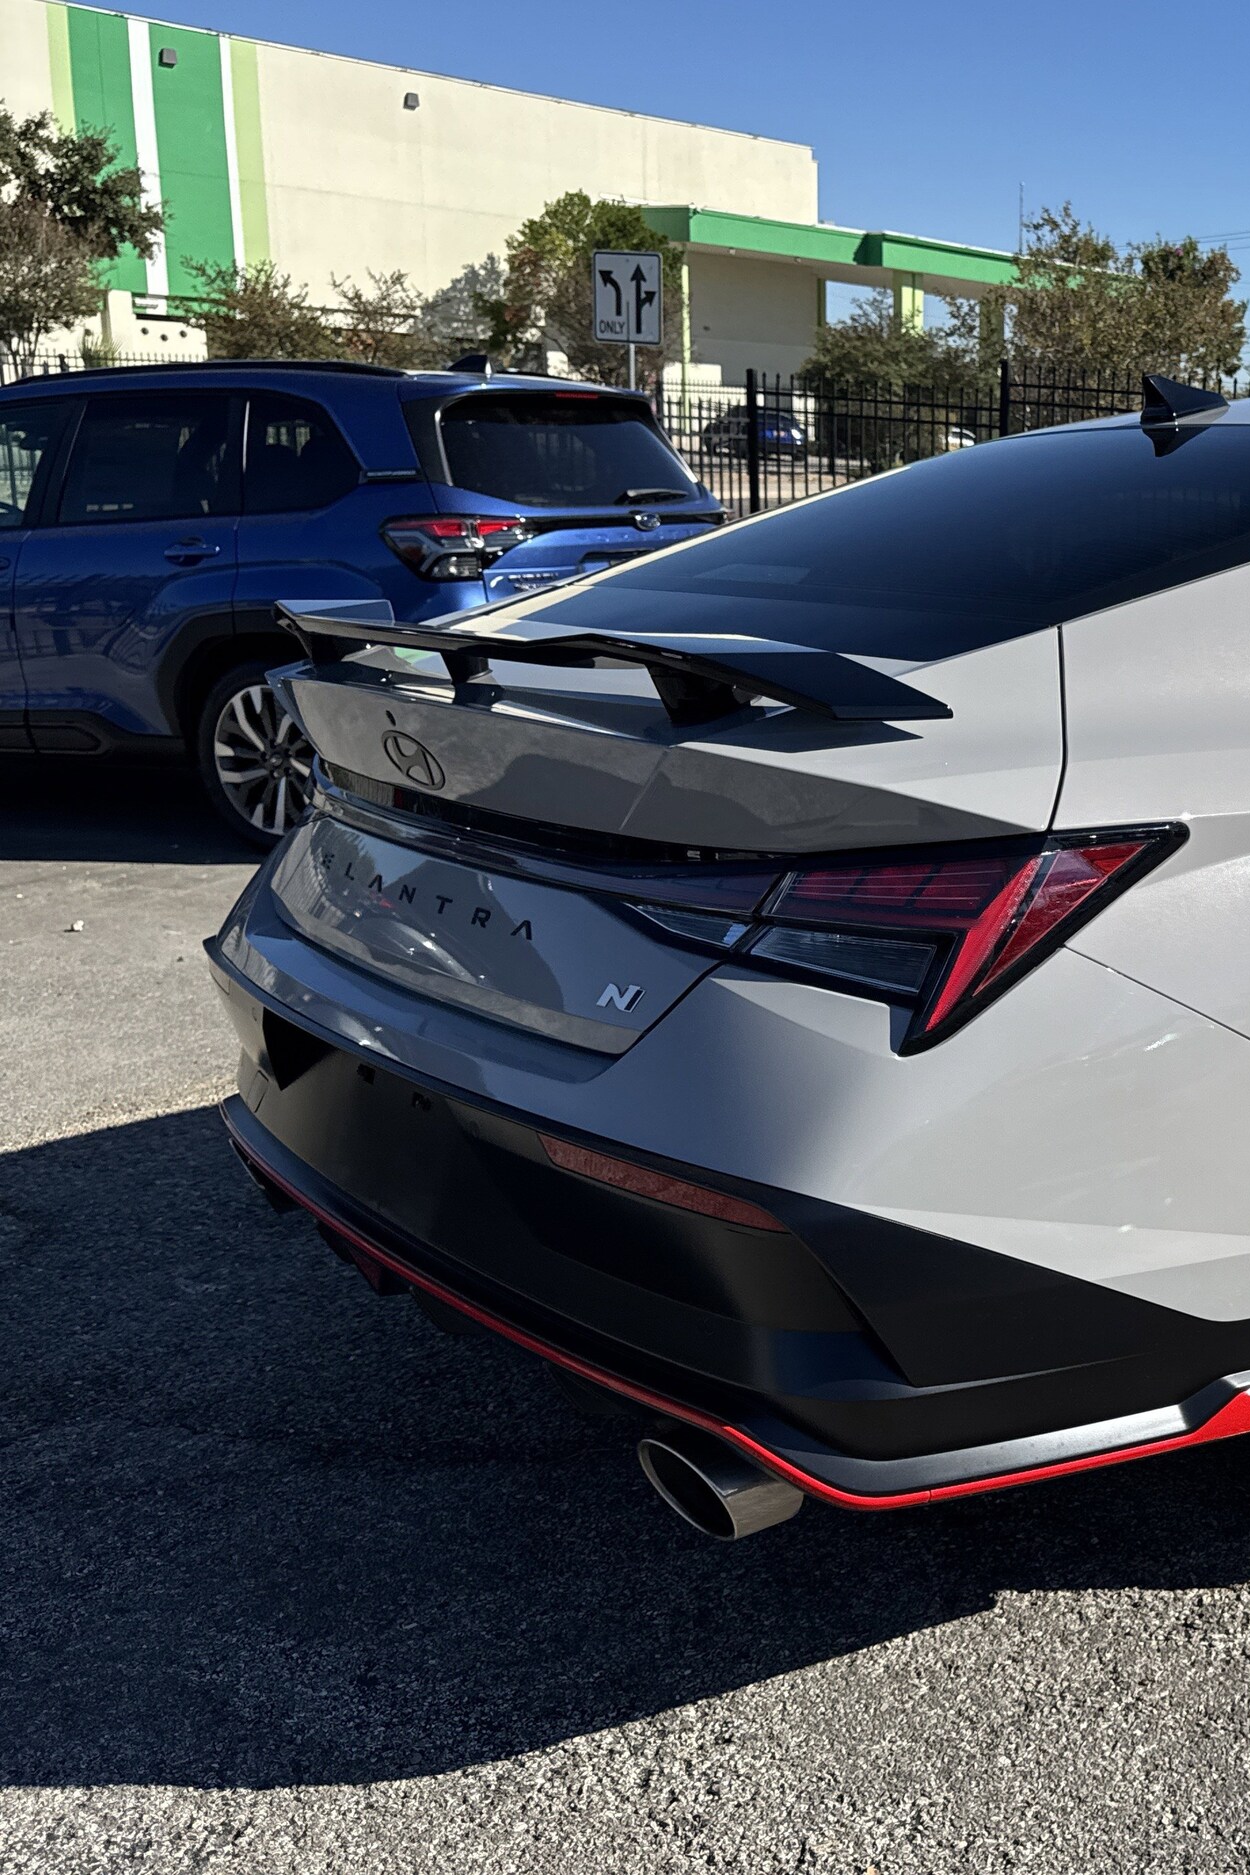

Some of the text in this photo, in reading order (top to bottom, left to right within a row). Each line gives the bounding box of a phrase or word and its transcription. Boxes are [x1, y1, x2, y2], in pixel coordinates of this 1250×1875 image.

[599, 320, 625, 334] ONLY
[319, 852, 534, 942] ELANTRA
[596, 981, 645, 1014] N
